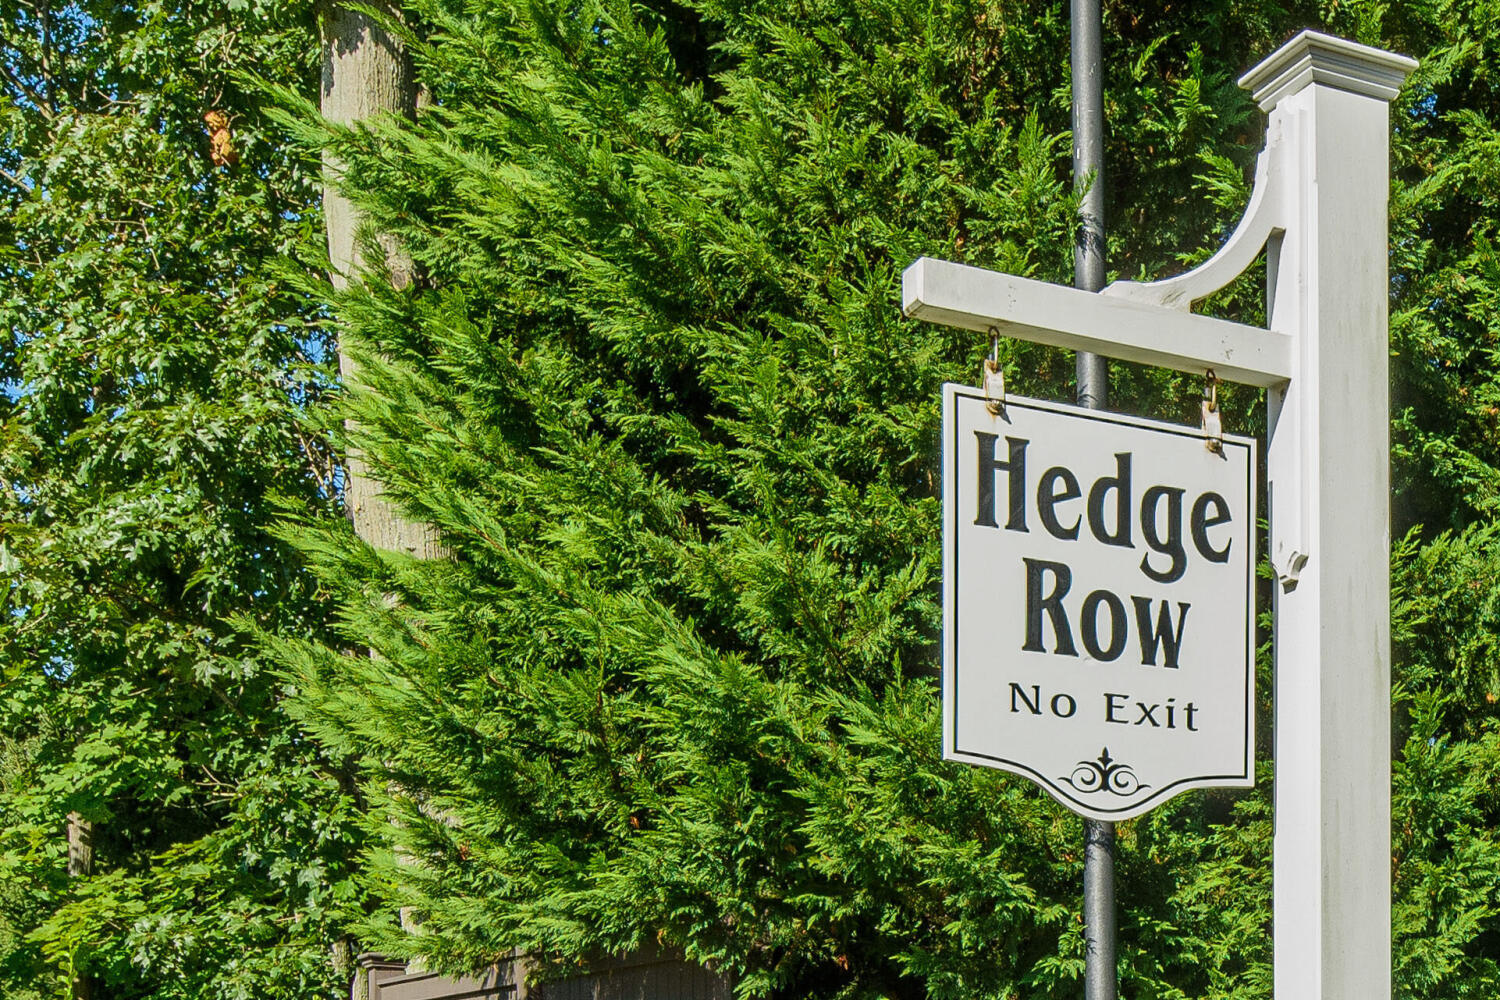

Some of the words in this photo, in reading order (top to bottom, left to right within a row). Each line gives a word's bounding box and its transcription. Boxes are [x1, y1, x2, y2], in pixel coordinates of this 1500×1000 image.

[973, 430, 1233, 584] Hedge
[1021, 557, 1192, 670] Row
[1008, 682, 1078, 719] No
[1103, 692, 1200, 732] Exit
